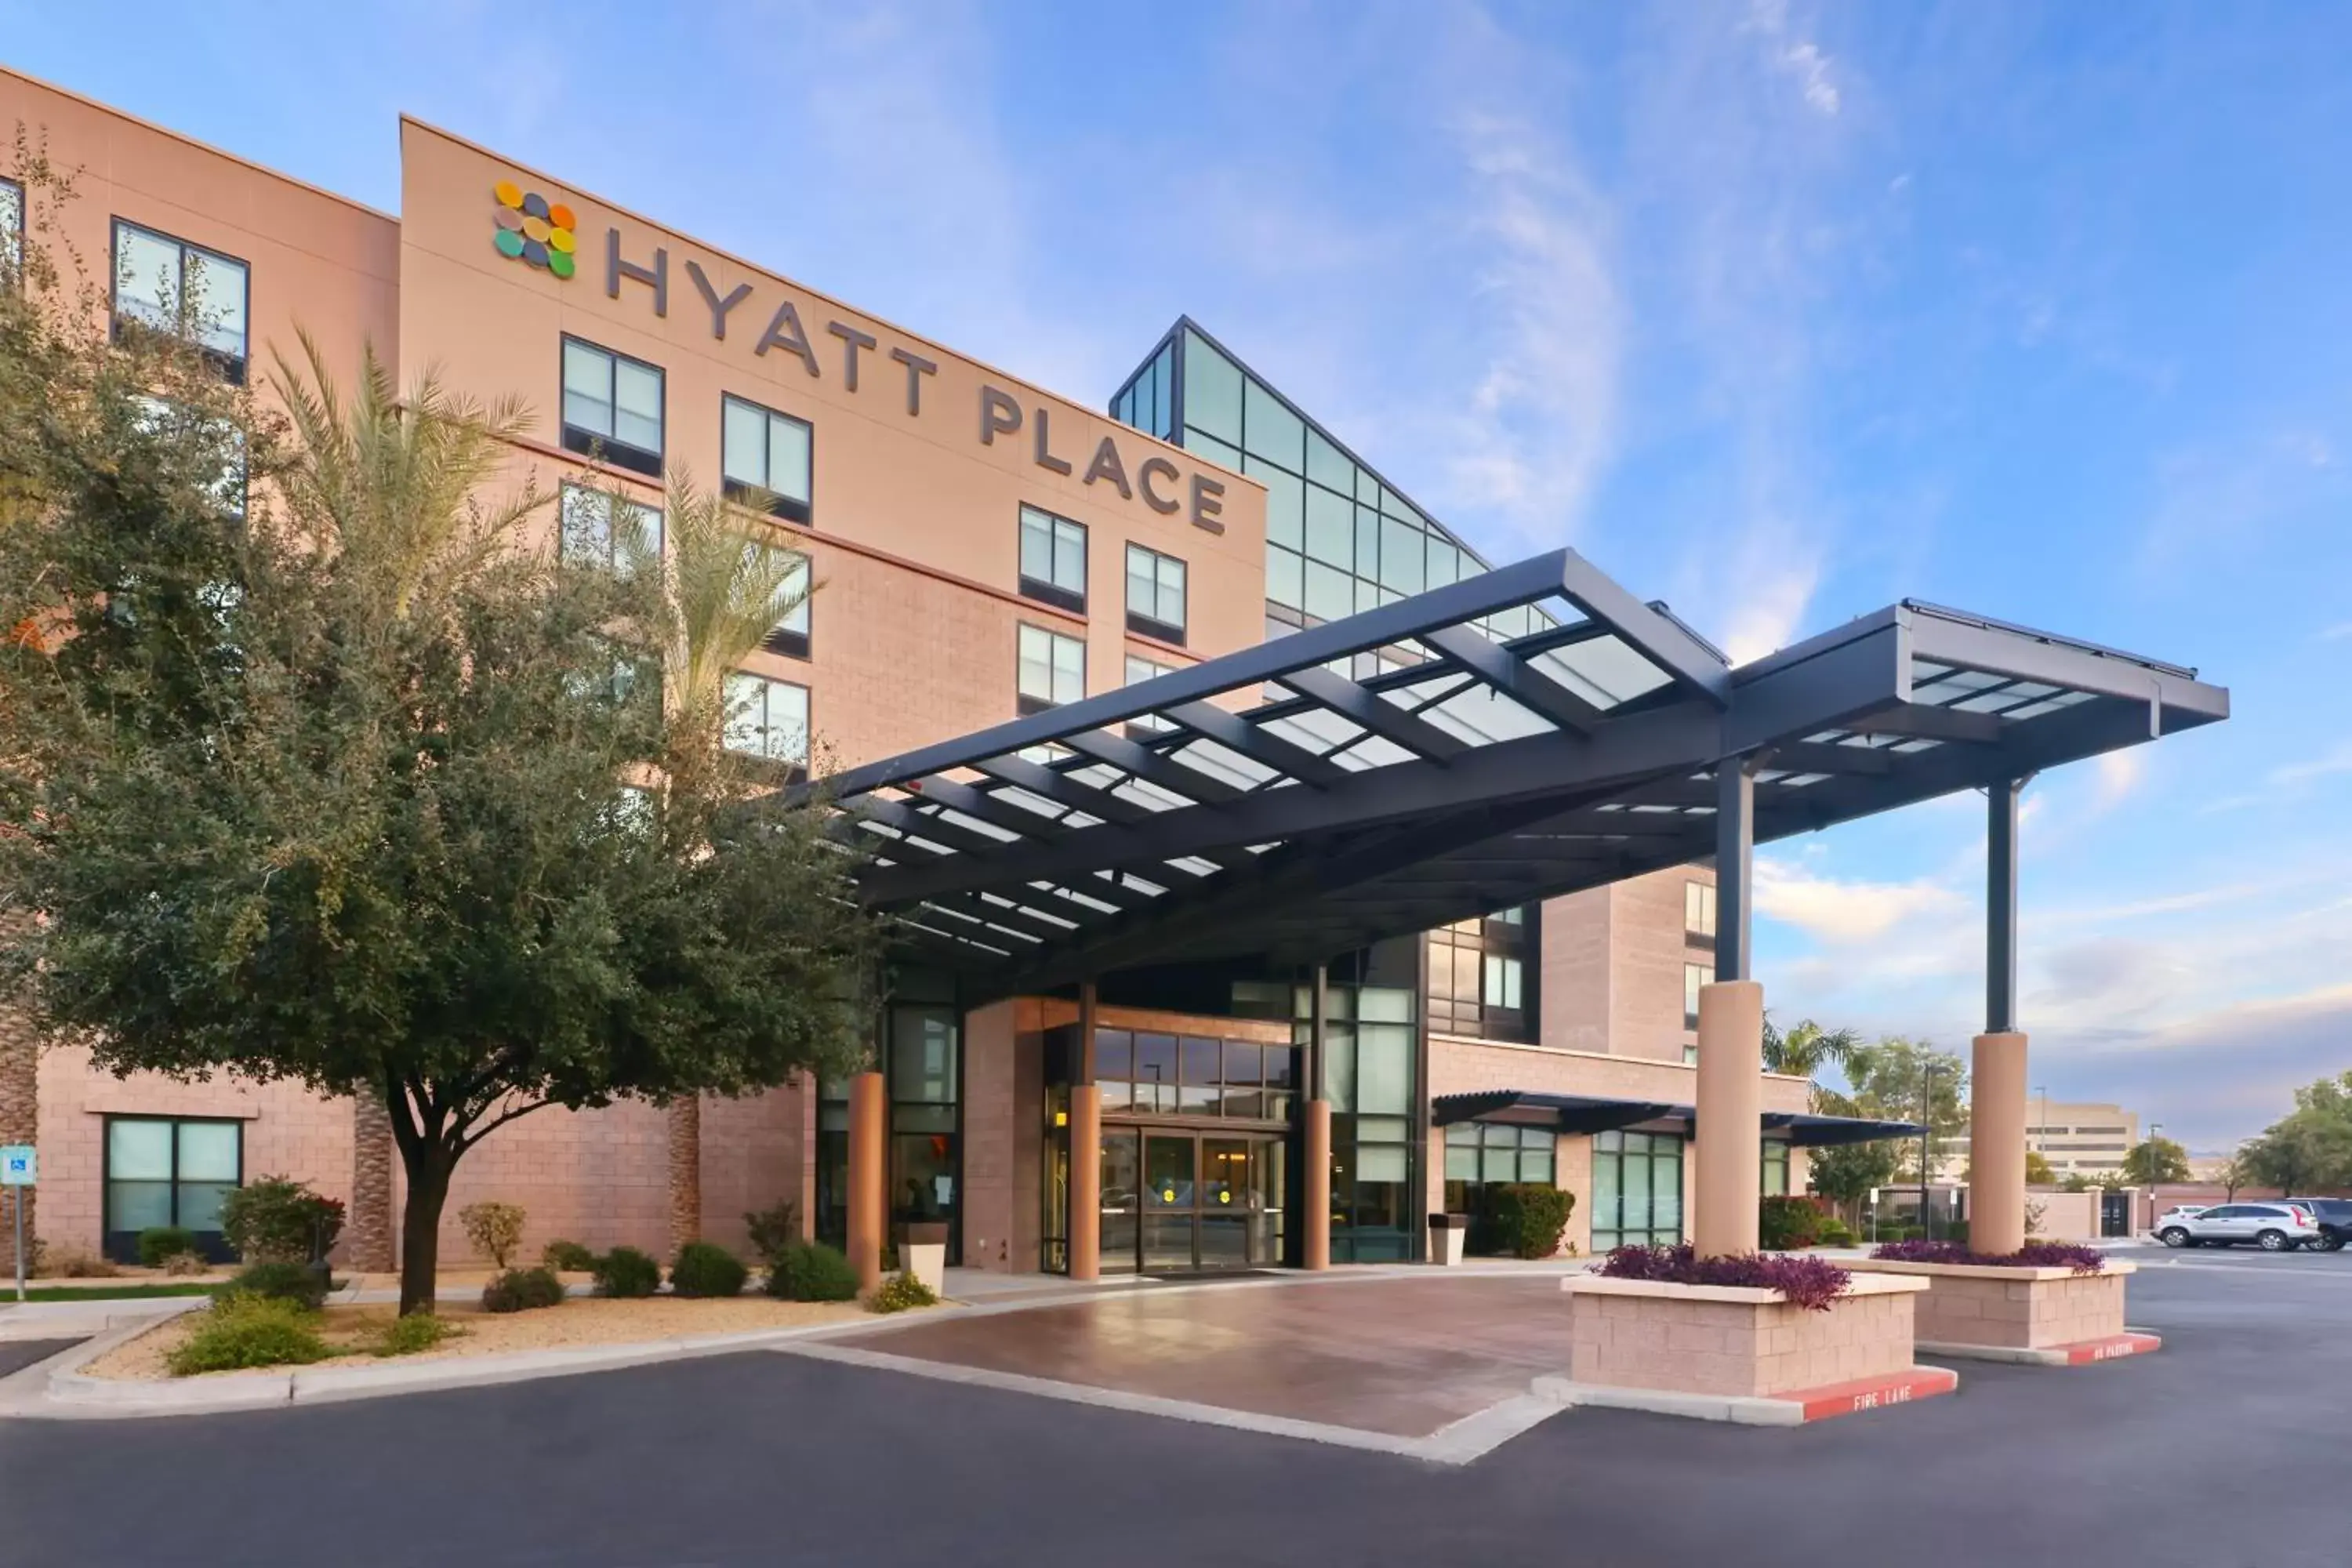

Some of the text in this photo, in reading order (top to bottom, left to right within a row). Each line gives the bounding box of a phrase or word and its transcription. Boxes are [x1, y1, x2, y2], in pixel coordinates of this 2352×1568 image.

[606, 227, 1225, 537] HYATT PLACE
[1854, 1385, 1911, 1411] FIRE LANE
